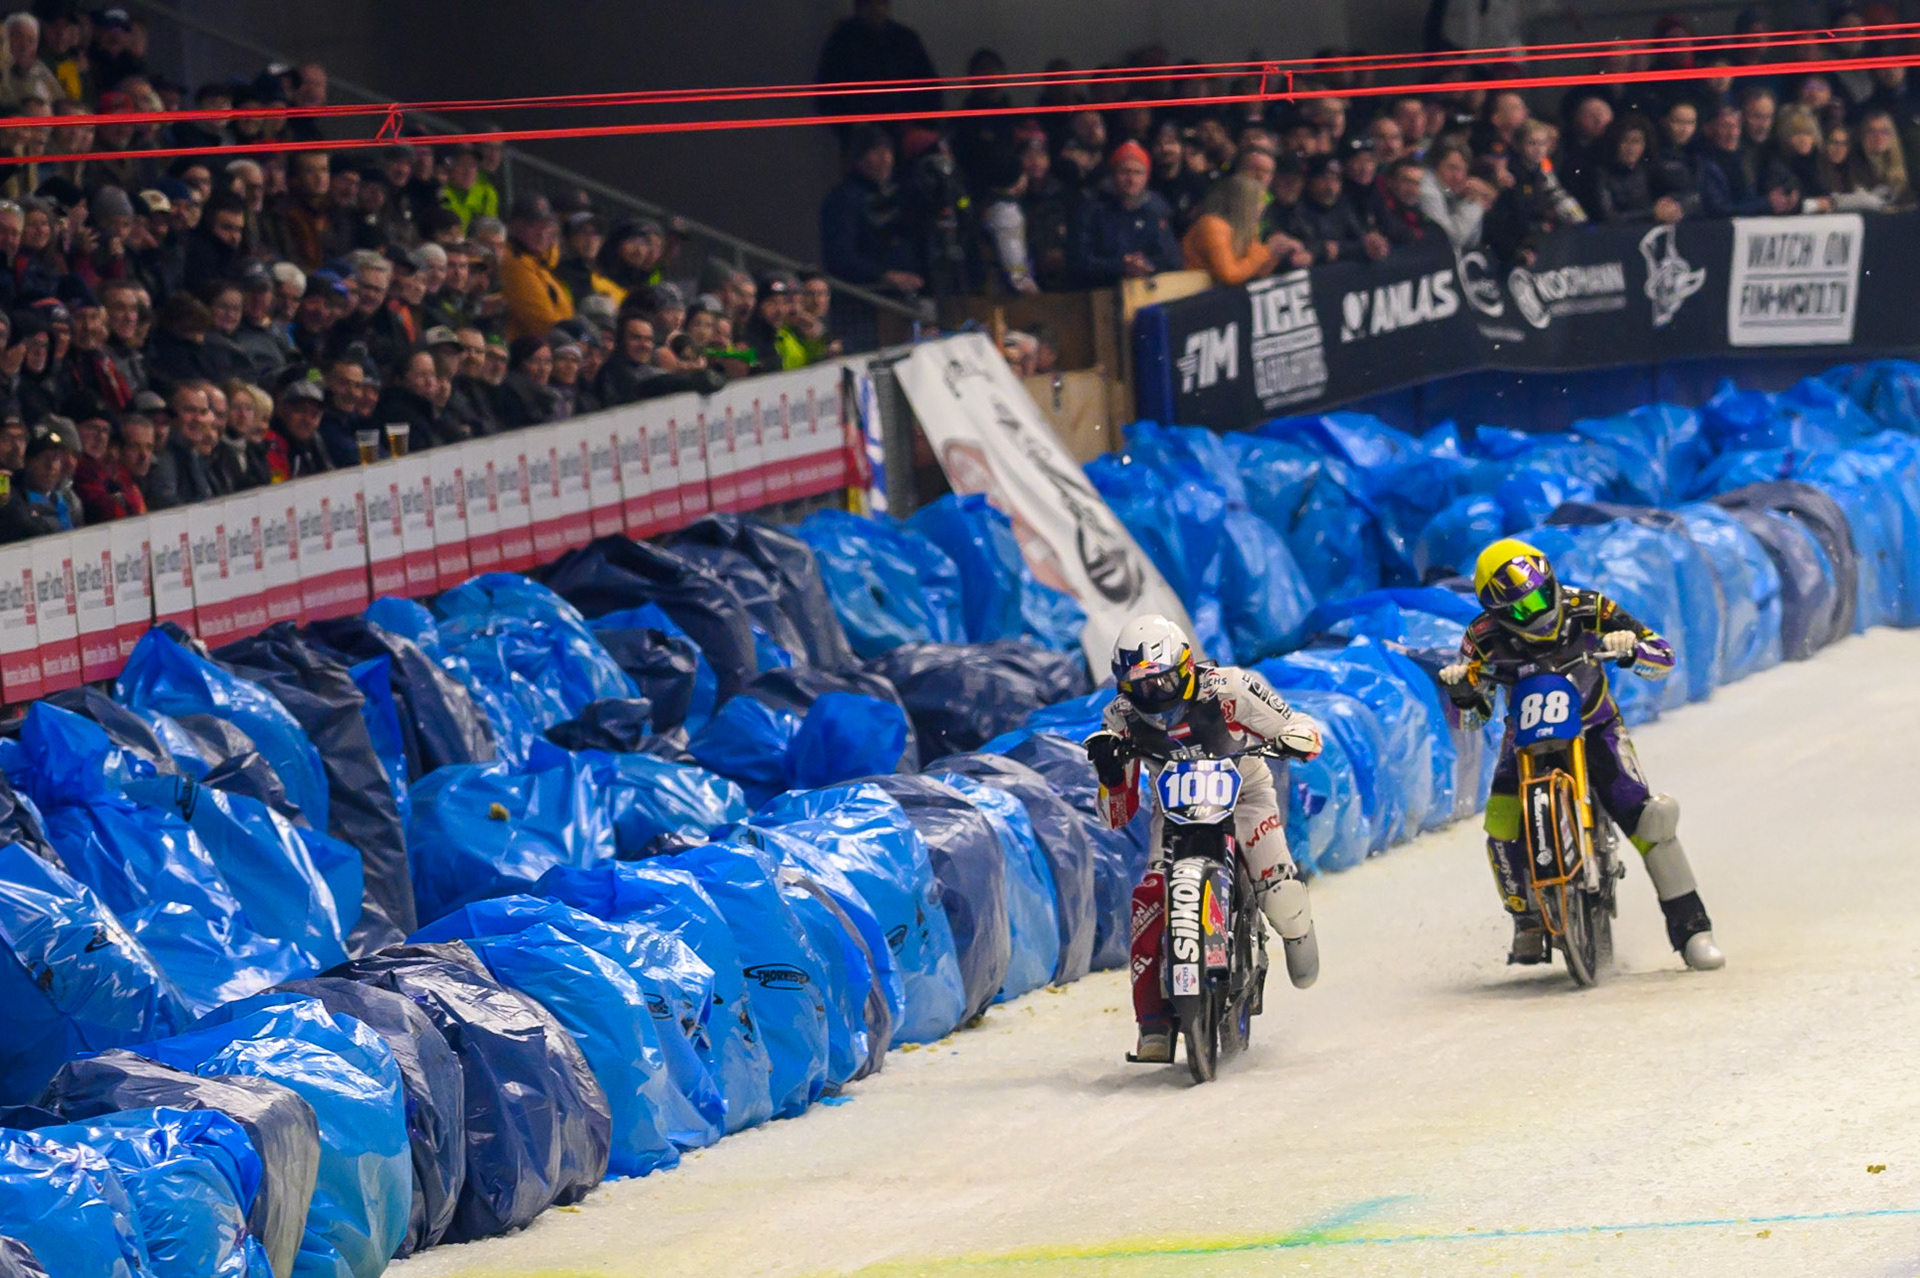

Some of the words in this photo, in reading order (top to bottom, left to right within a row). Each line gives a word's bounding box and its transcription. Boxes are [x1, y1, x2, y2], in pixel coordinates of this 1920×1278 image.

[1748, 233, 1816, 268] WATCH
[1824, 231, 1853, 266] ON
[1251, 279, 1317, 338] ICE
[1520, 690, 1570, 730] 88
[1166, 771, 1233, 808] 100
[1184, 805, 1212, 818] FIM
